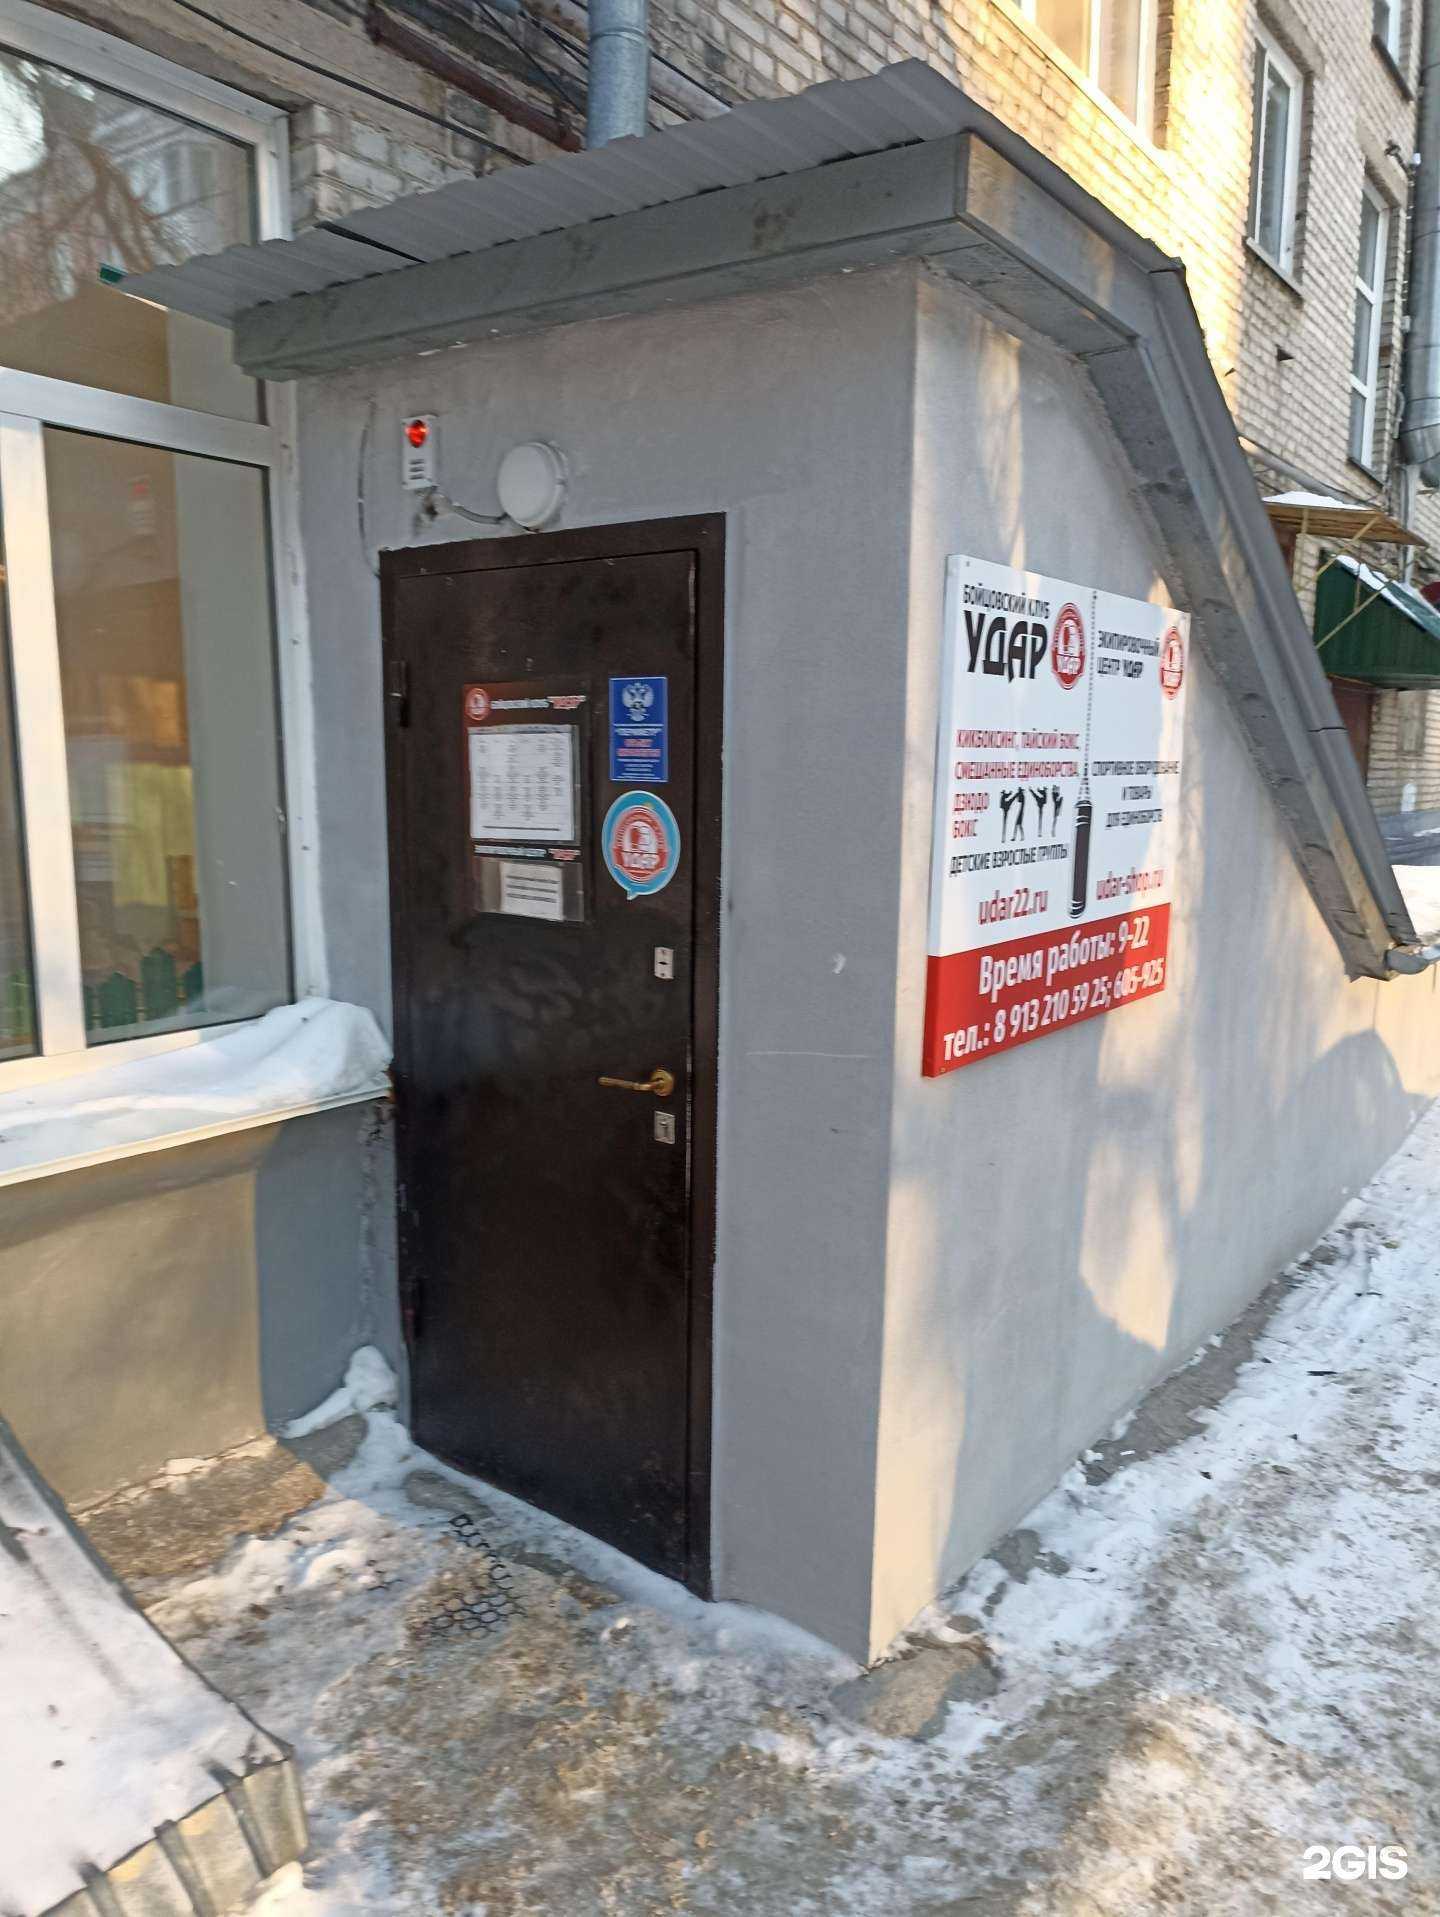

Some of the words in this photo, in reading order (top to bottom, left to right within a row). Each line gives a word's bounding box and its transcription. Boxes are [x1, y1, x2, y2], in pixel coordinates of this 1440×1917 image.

[963, 583, 1026, 613] БОЙЦОВСКИЙ
[1029, 598, 1050, 619] КЛУБ
[963, 609, 1048, 683] УДАР
[1021, 728, 1058, 749] ТАЙСКИЙ
[955, 761, 1015, 780] СМЕШАННЫЕ
[952, 818, 979, 839] БОКС
[949, 852, 991, 877] ДЕТСКИЕ
[992, 846, 1036, 870] ВЗРОСЛЫЕ
[1037, 843, 1070, 864] ГРУППЫ
[1096, 866, 1164, 901] udar-shop.ru
[978, 887, 1049, 926] udar22.ru
[978, 948, 1044, 1003] Время
[1045, 930, 1116, 987] работы:
[1118, 915, 1151, 954] 9-22
[943, 1022, 990, 1061] тел.:
[993, 1008, 1007, 1043] 8
[1009, 998, 1040, 1038] 913
[1041, 988, 1069, 1028] 210
[1070, 982, 1090, 1016] 59
[1090, 975, 1112, 1009] 25;
[1113, 957, 1166, 1000] 605-925
